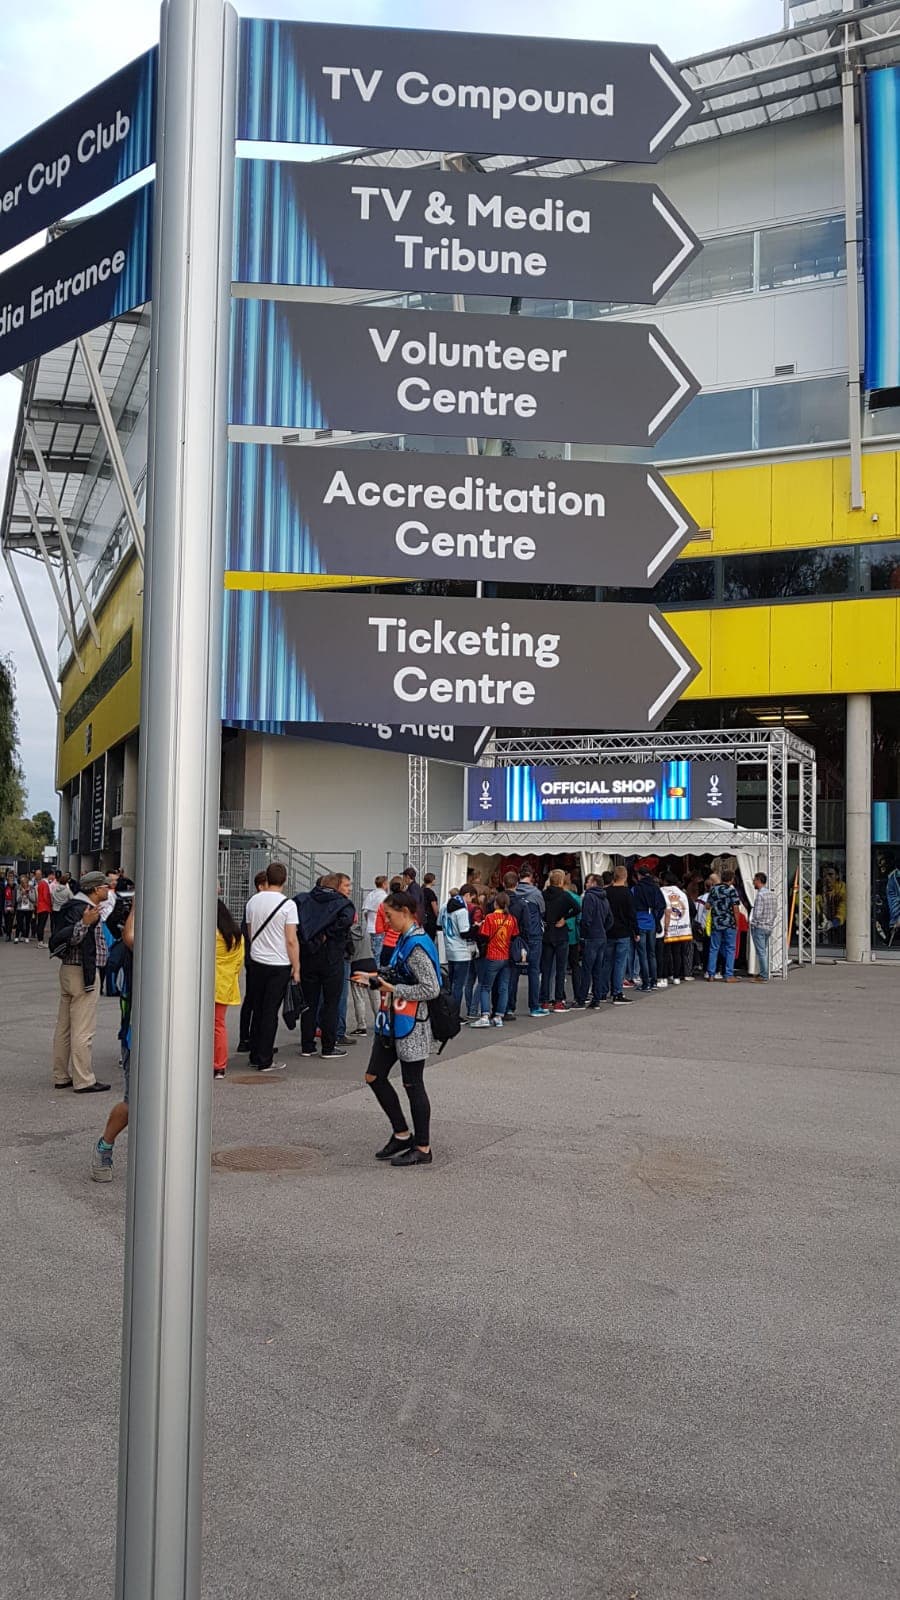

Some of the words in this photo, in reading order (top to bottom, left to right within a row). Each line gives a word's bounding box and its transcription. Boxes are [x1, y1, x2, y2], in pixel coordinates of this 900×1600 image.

[322, 66, 383, 102] TV
[396, 71, 614, 119] Compound
[0, 183, 22, 213] er
[27, 154, 71, 195] Cup
[77, 110, 130, 164] Club
[351, 186, 412, 222] TV
[424, 191, 455, 226] &
[467, 193, 590, 234] Media
[394, 234, 547, 276] Tribune
[30, 250, 126, 320] Entrance
[368, 328, 567, 373] Volunteer
[396, 376, 537, 418] Centre
[322, 470, 605, 517] Accreditation
[395, 520, 536, 561] Centre
[368, 617, 561, 668] Ticketing
[393, 666, 536, 706] Centre
[540, 780, 610, 795] OFFICIAL
[612, 779, 657, 794] SHOP
